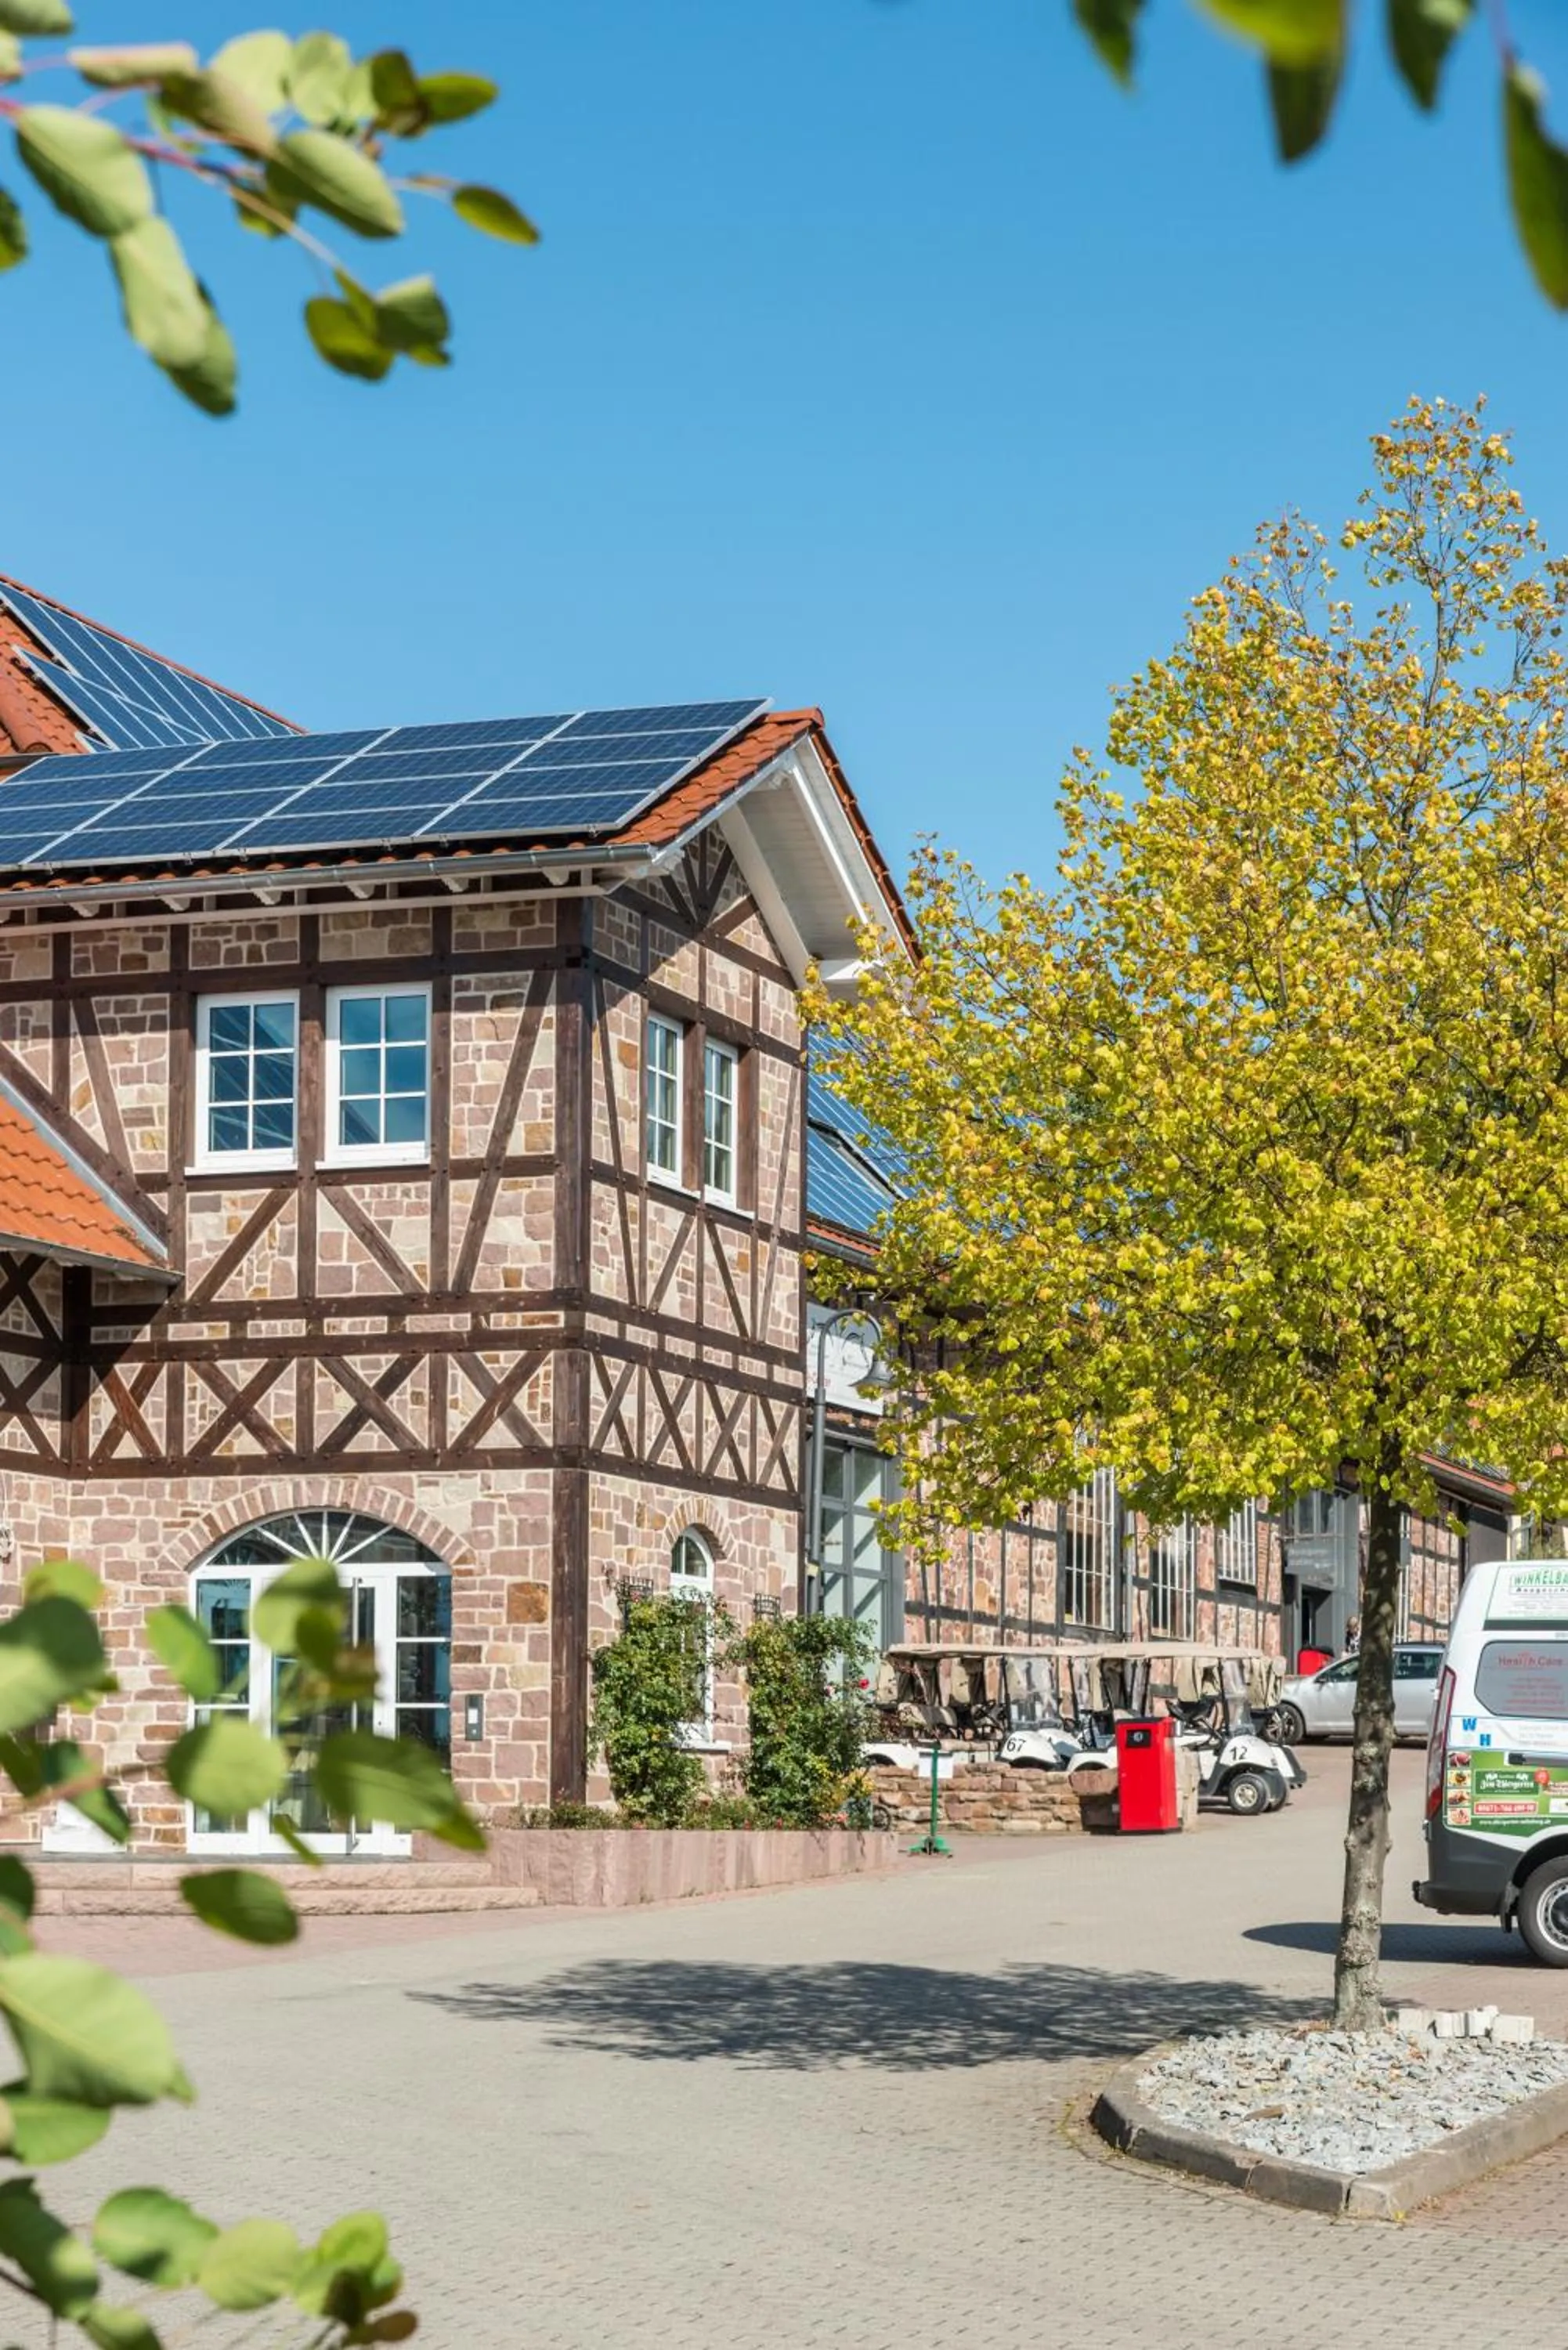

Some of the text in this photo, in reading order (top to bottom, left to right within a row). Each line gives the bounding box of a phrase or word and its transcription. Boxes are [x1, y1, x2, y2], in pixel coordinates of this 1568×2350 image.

[1462, 1717, 1477, 1731] W
[1006, 1737, 1026, 1752] 67
[1479, 1734, 1491, 1746] H
[1230, 1746, 1248, 1761] 12
